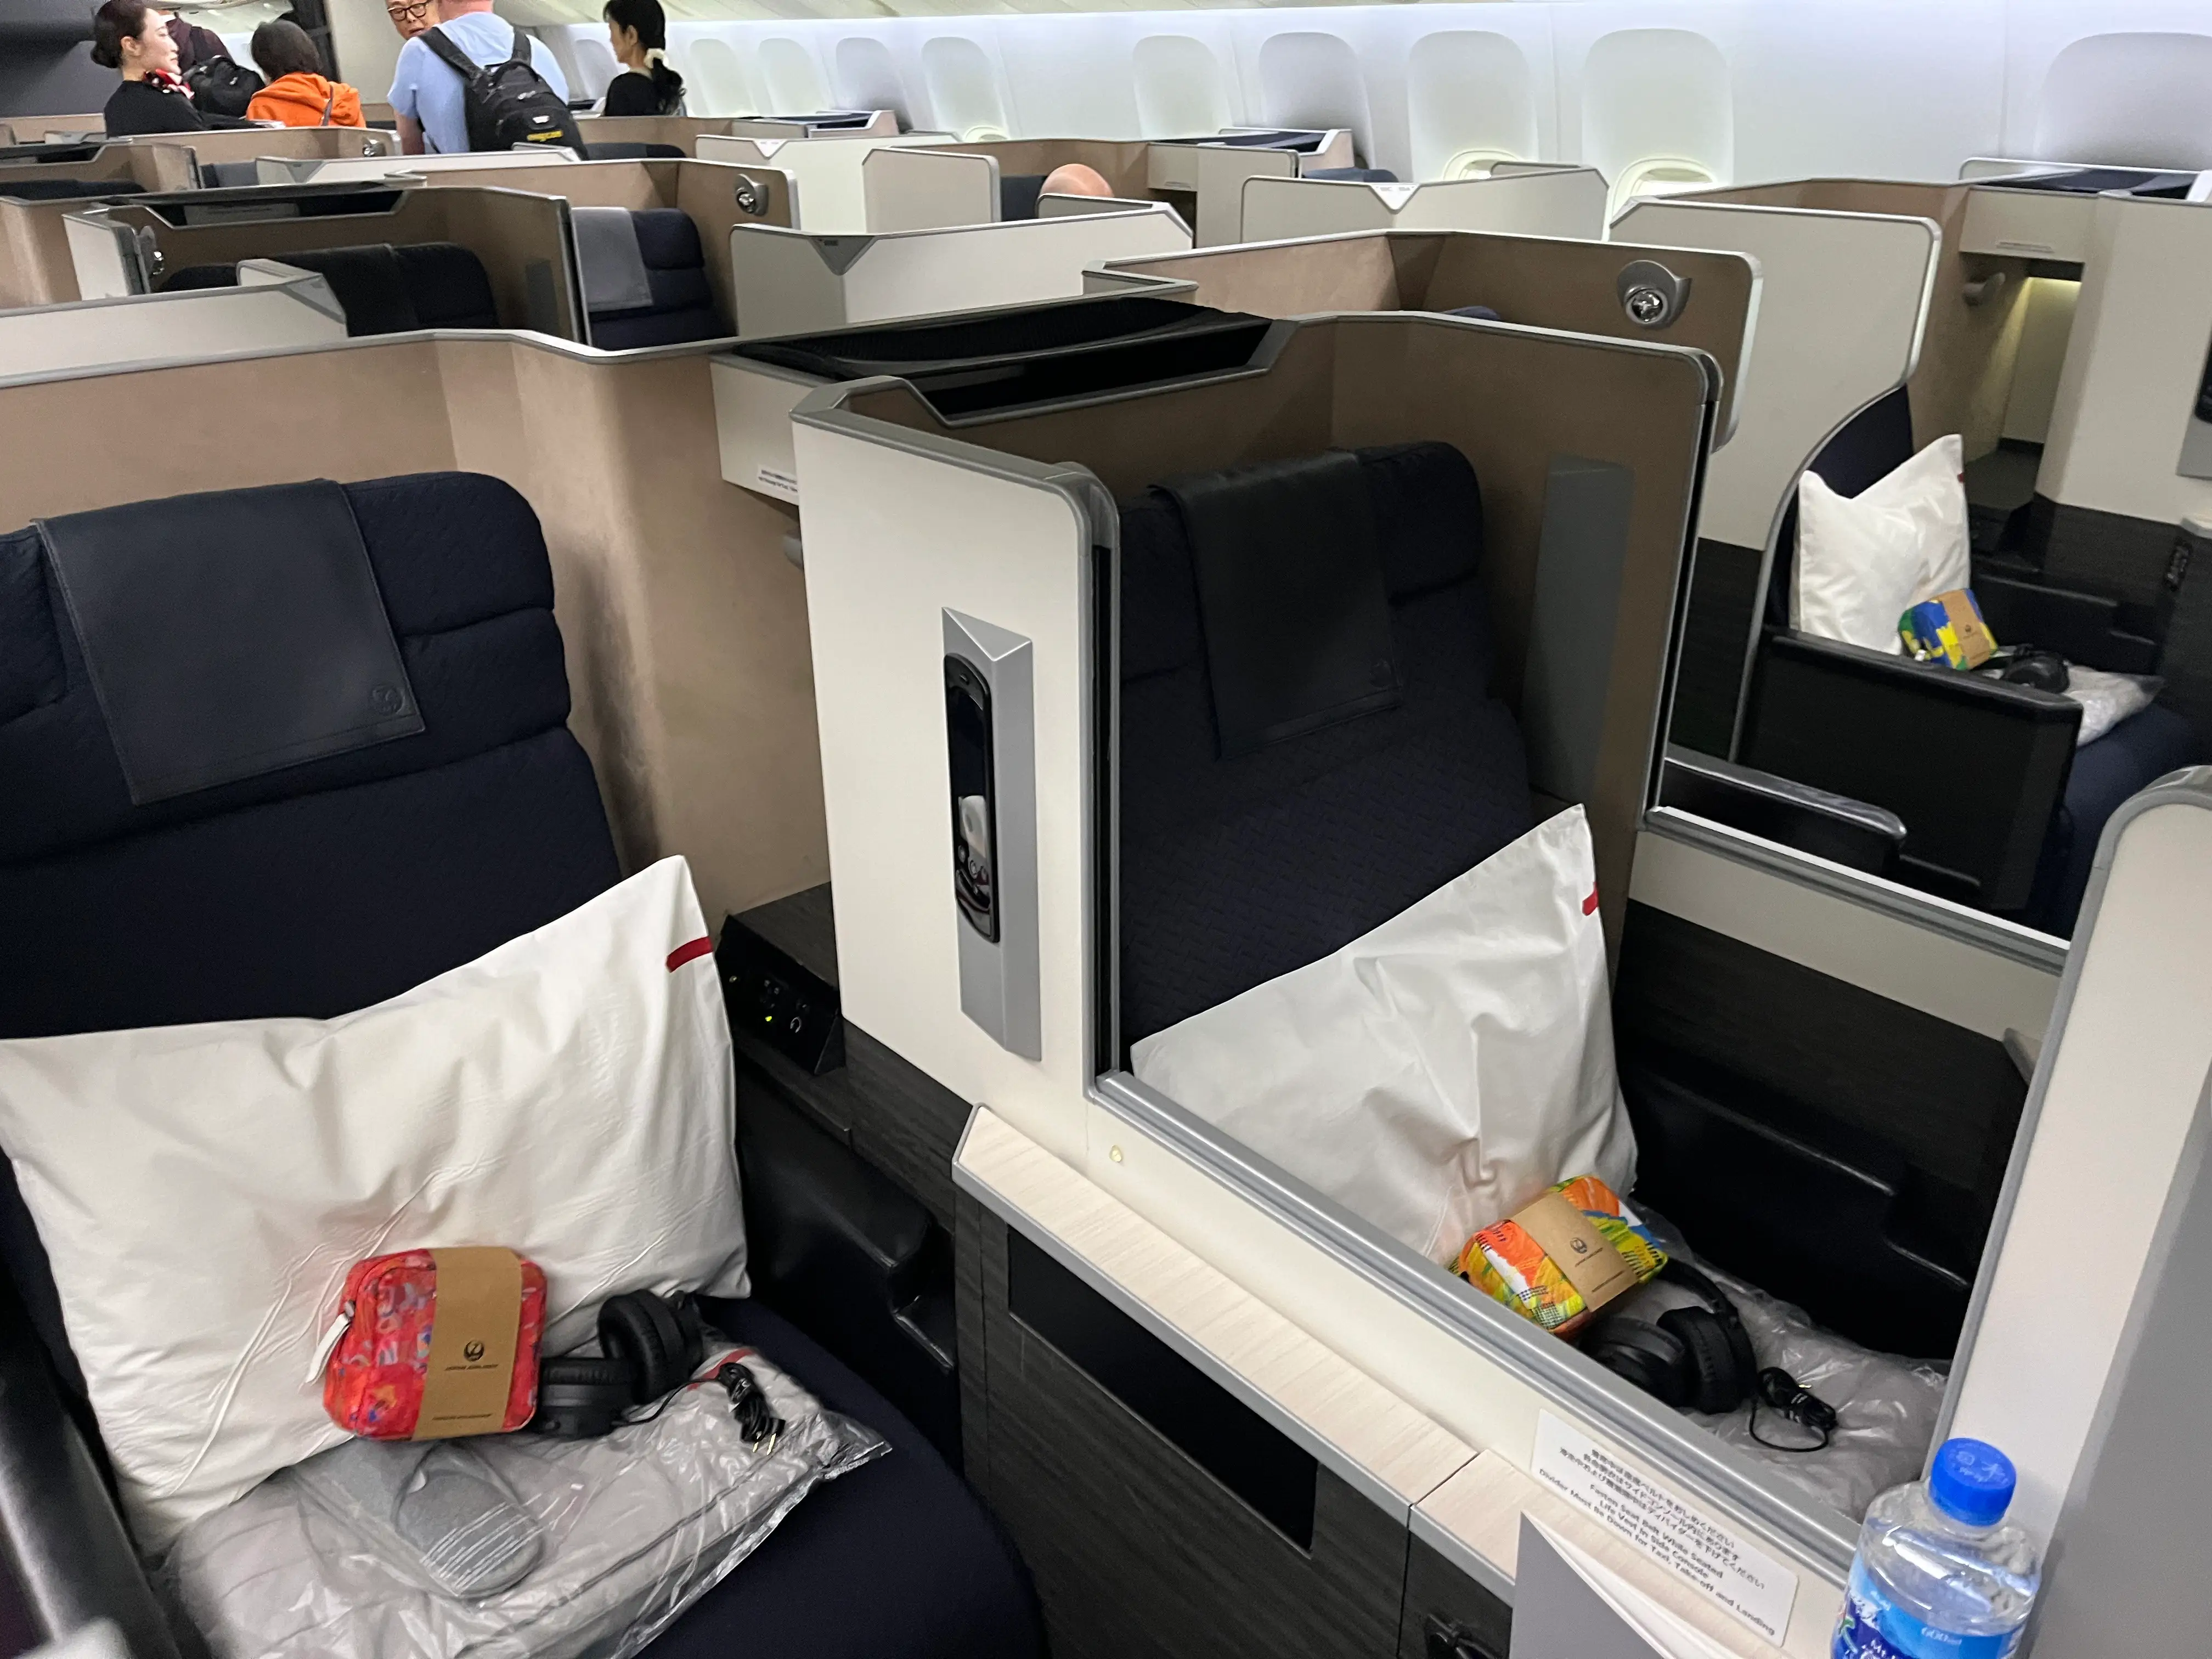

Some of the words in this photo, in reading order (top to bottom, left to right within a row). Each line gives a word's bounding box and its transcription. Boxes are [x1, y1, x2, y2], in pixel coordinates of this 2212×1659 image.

[1570, 1489, 1592, 1509] Must
[1606, 1515, 1633, 1537] Down
[1716, 1592, 1735, 1607] and
[1736, 1604, 1775, 1637] Landing
[1590, 1484, 1618, 1508] Fasten
[1620, 1504, 1640, 1522] Seat
[1691, 1553, 1724, 1579] Seated
[1672, 1550, 1709, 1579] Console
